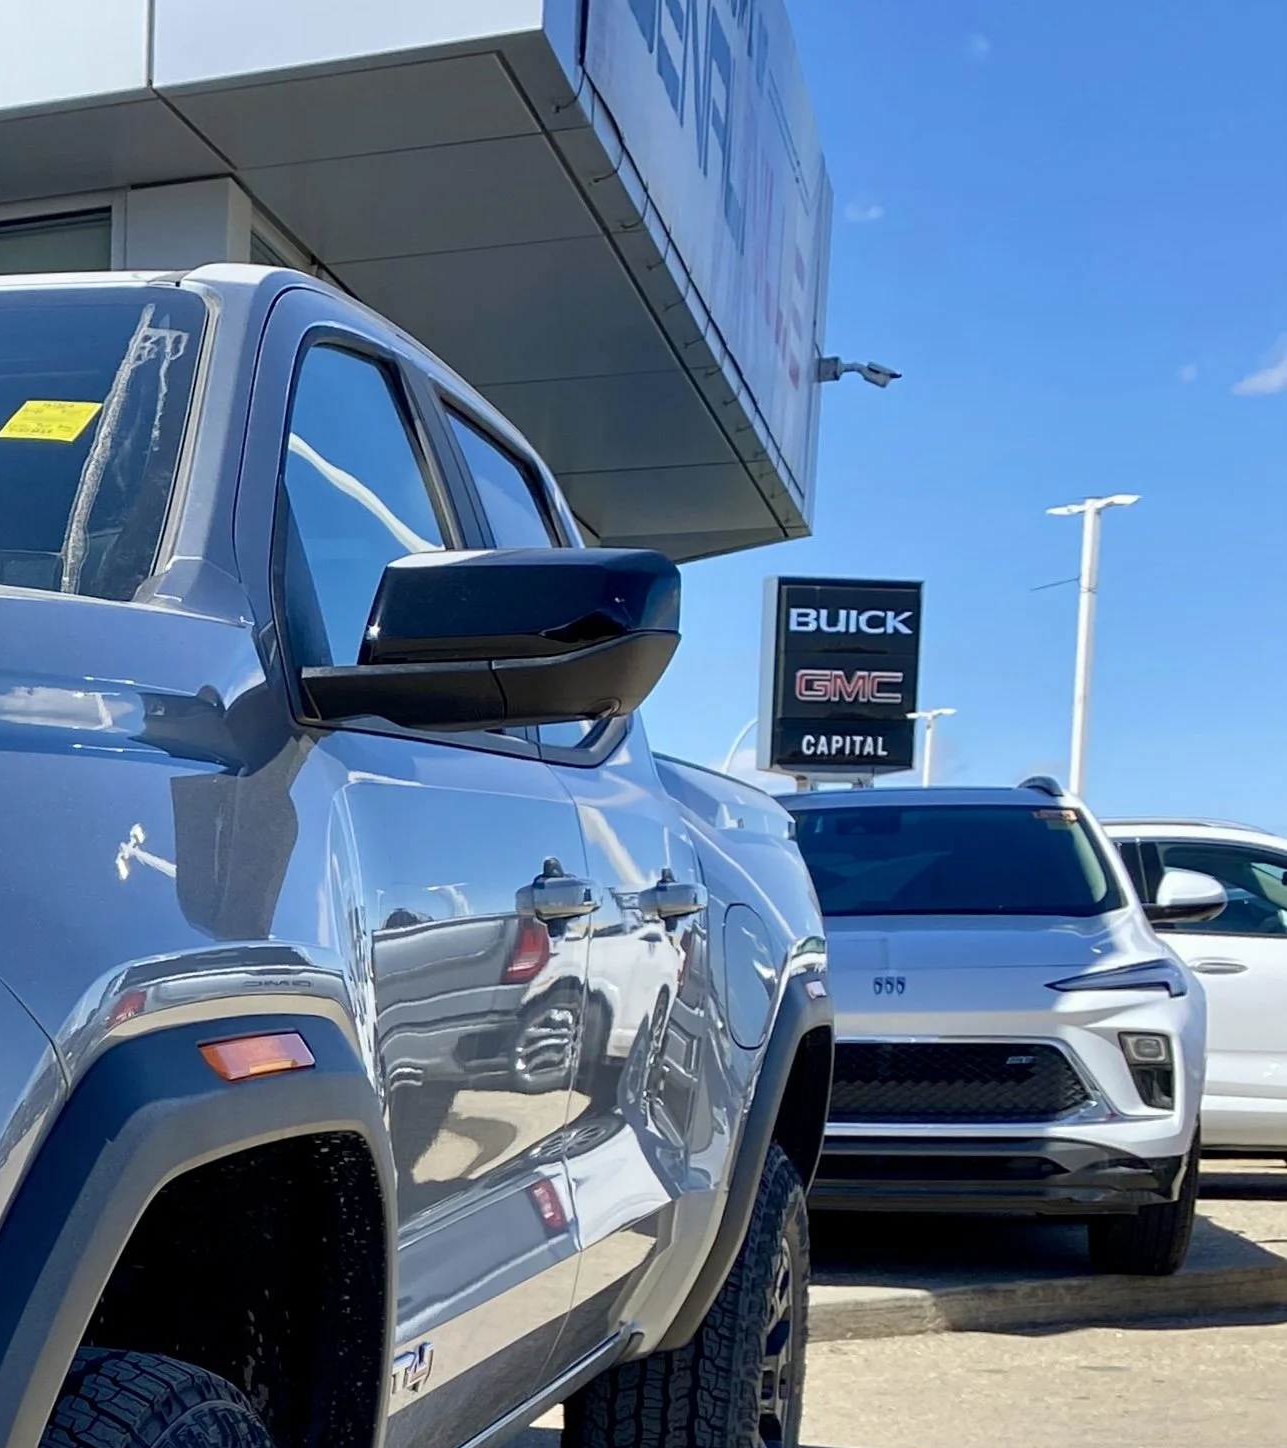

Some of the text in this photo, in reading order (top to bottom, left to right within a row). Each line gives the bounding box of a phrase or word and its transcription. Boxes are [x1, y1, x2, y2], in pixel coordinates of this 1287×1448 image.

[789, 607, 914, 635] BUICK
[795, 669, 904, 704] GMC
[801, 735, 889, 756] CAPITAL
[392, 1341, 434, 1394] T4
